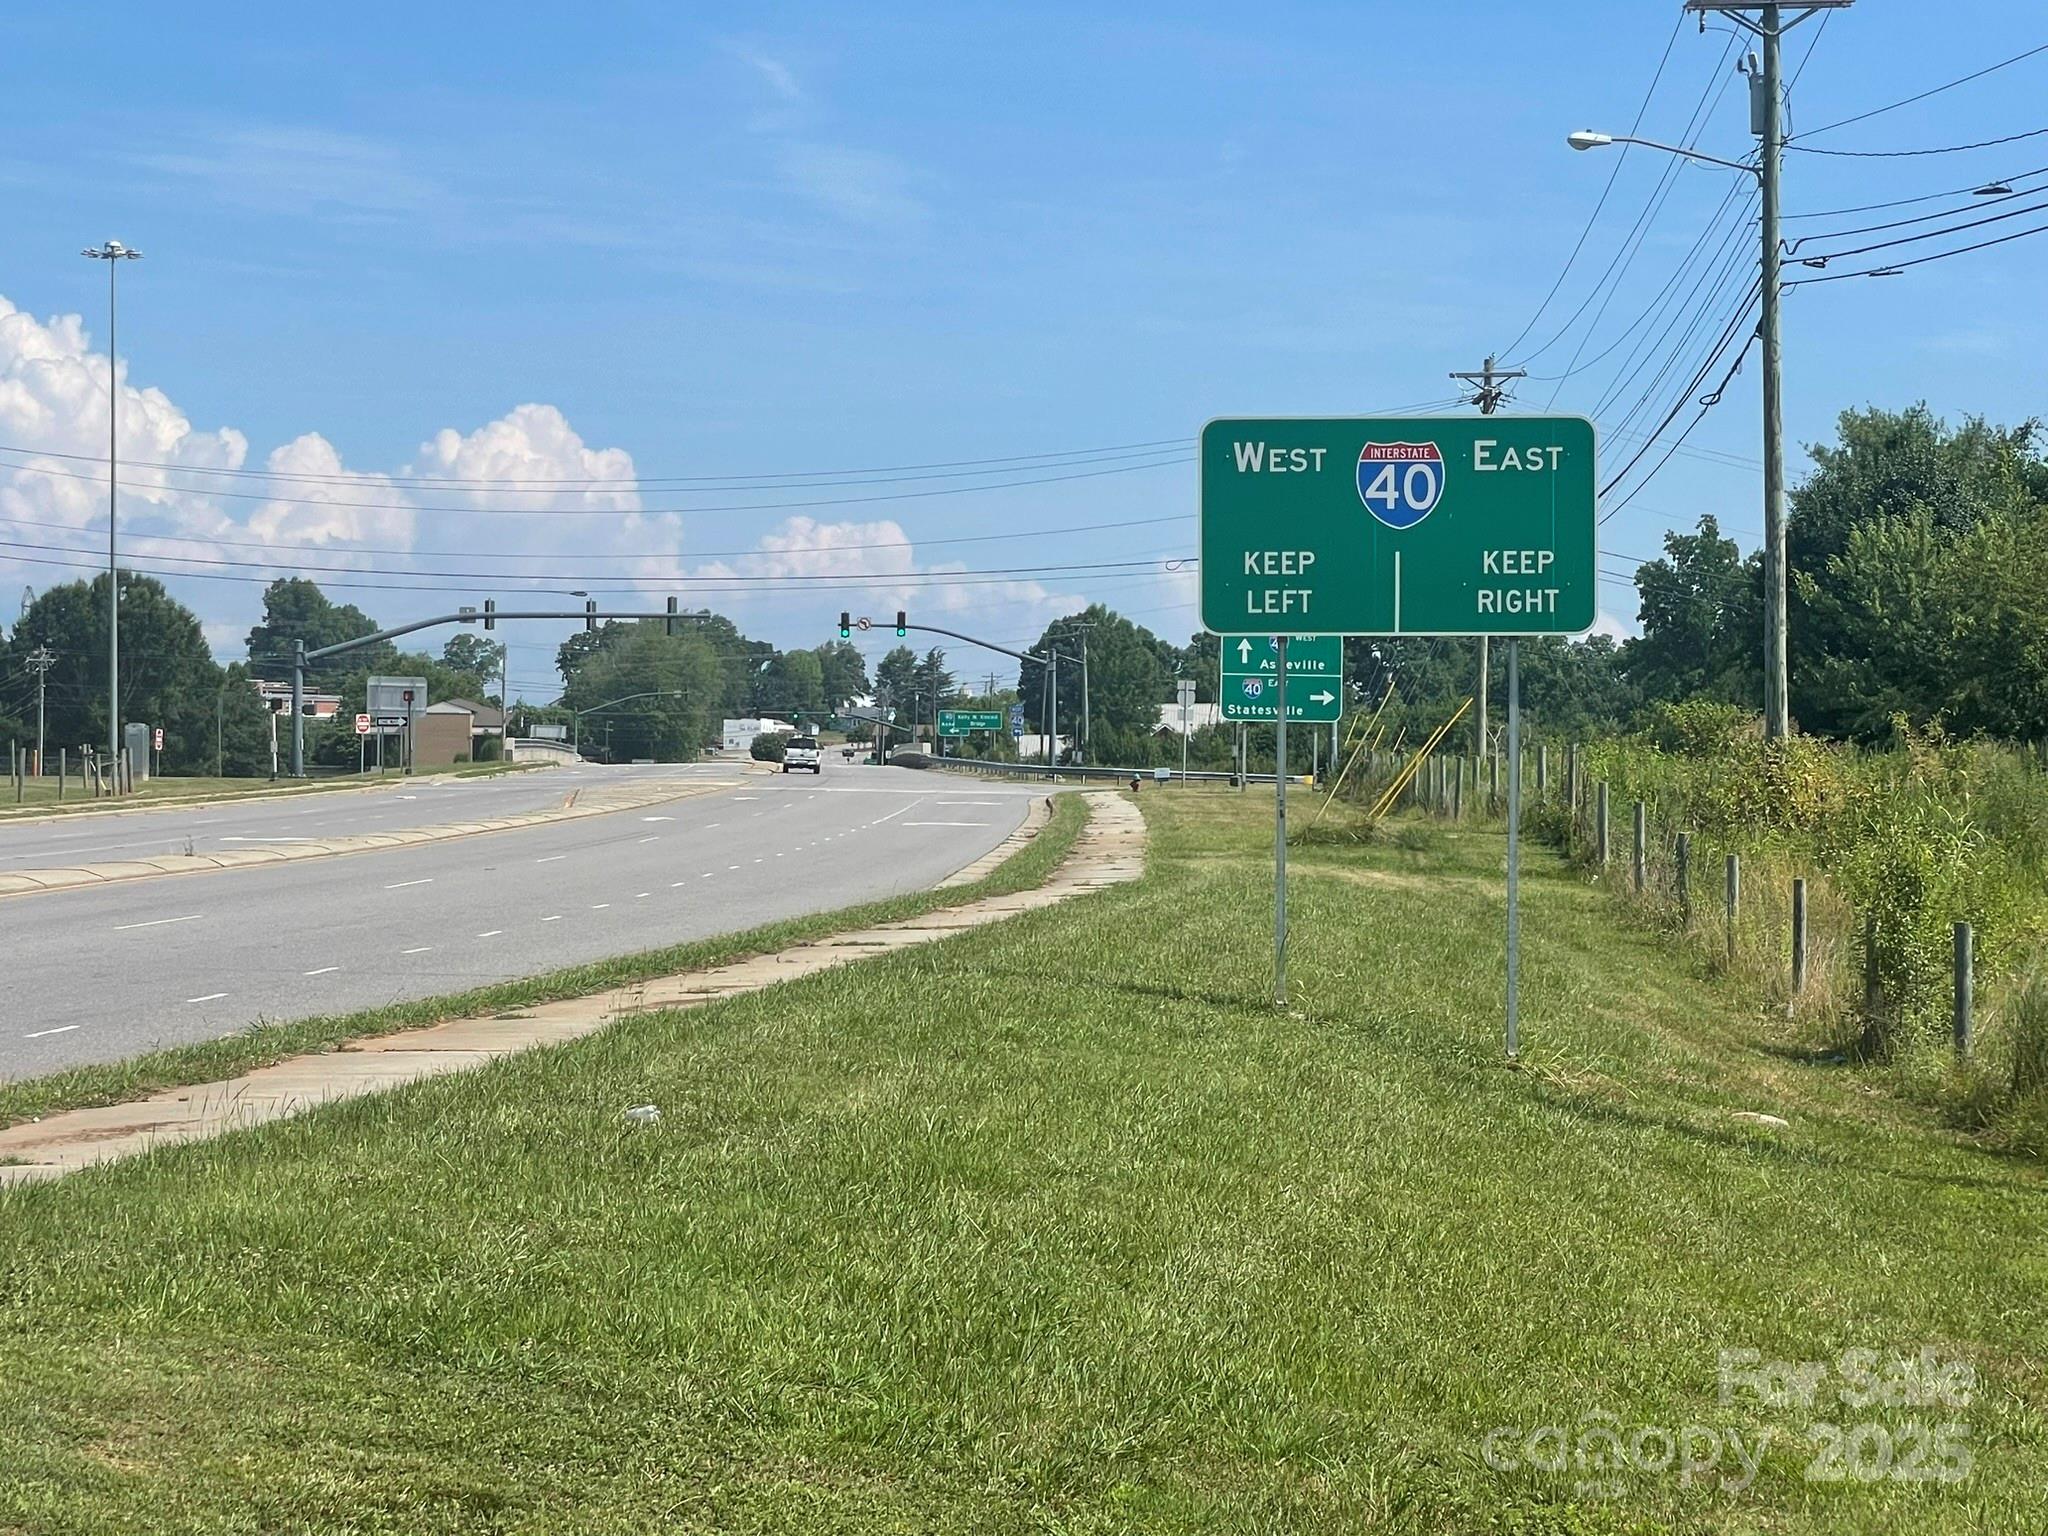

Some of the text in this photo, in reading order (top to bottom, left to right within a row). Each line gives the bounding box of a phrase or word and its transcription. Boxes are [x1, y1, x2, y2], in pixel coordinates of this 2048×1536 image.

[1234, 442, 1327, 473] WEST
[1370, 447, 1431, 459] INTERSTATE
[1473, 440, 1564, 472] EAST
[1365, 464, 1437, 511] 40
[1244, 551, 1316, 576] KEEP
[1482, 550, 1555, 574] KEEP
[1247, 590, 1313, 614] LEFT
[1477, 589, 1560, 613] RIGHT
[1259, 659, 1326, 670] Aseville
[1244, 684, 1261, 695] 40
[1227, 704, 1304, 716] Statesvlle
